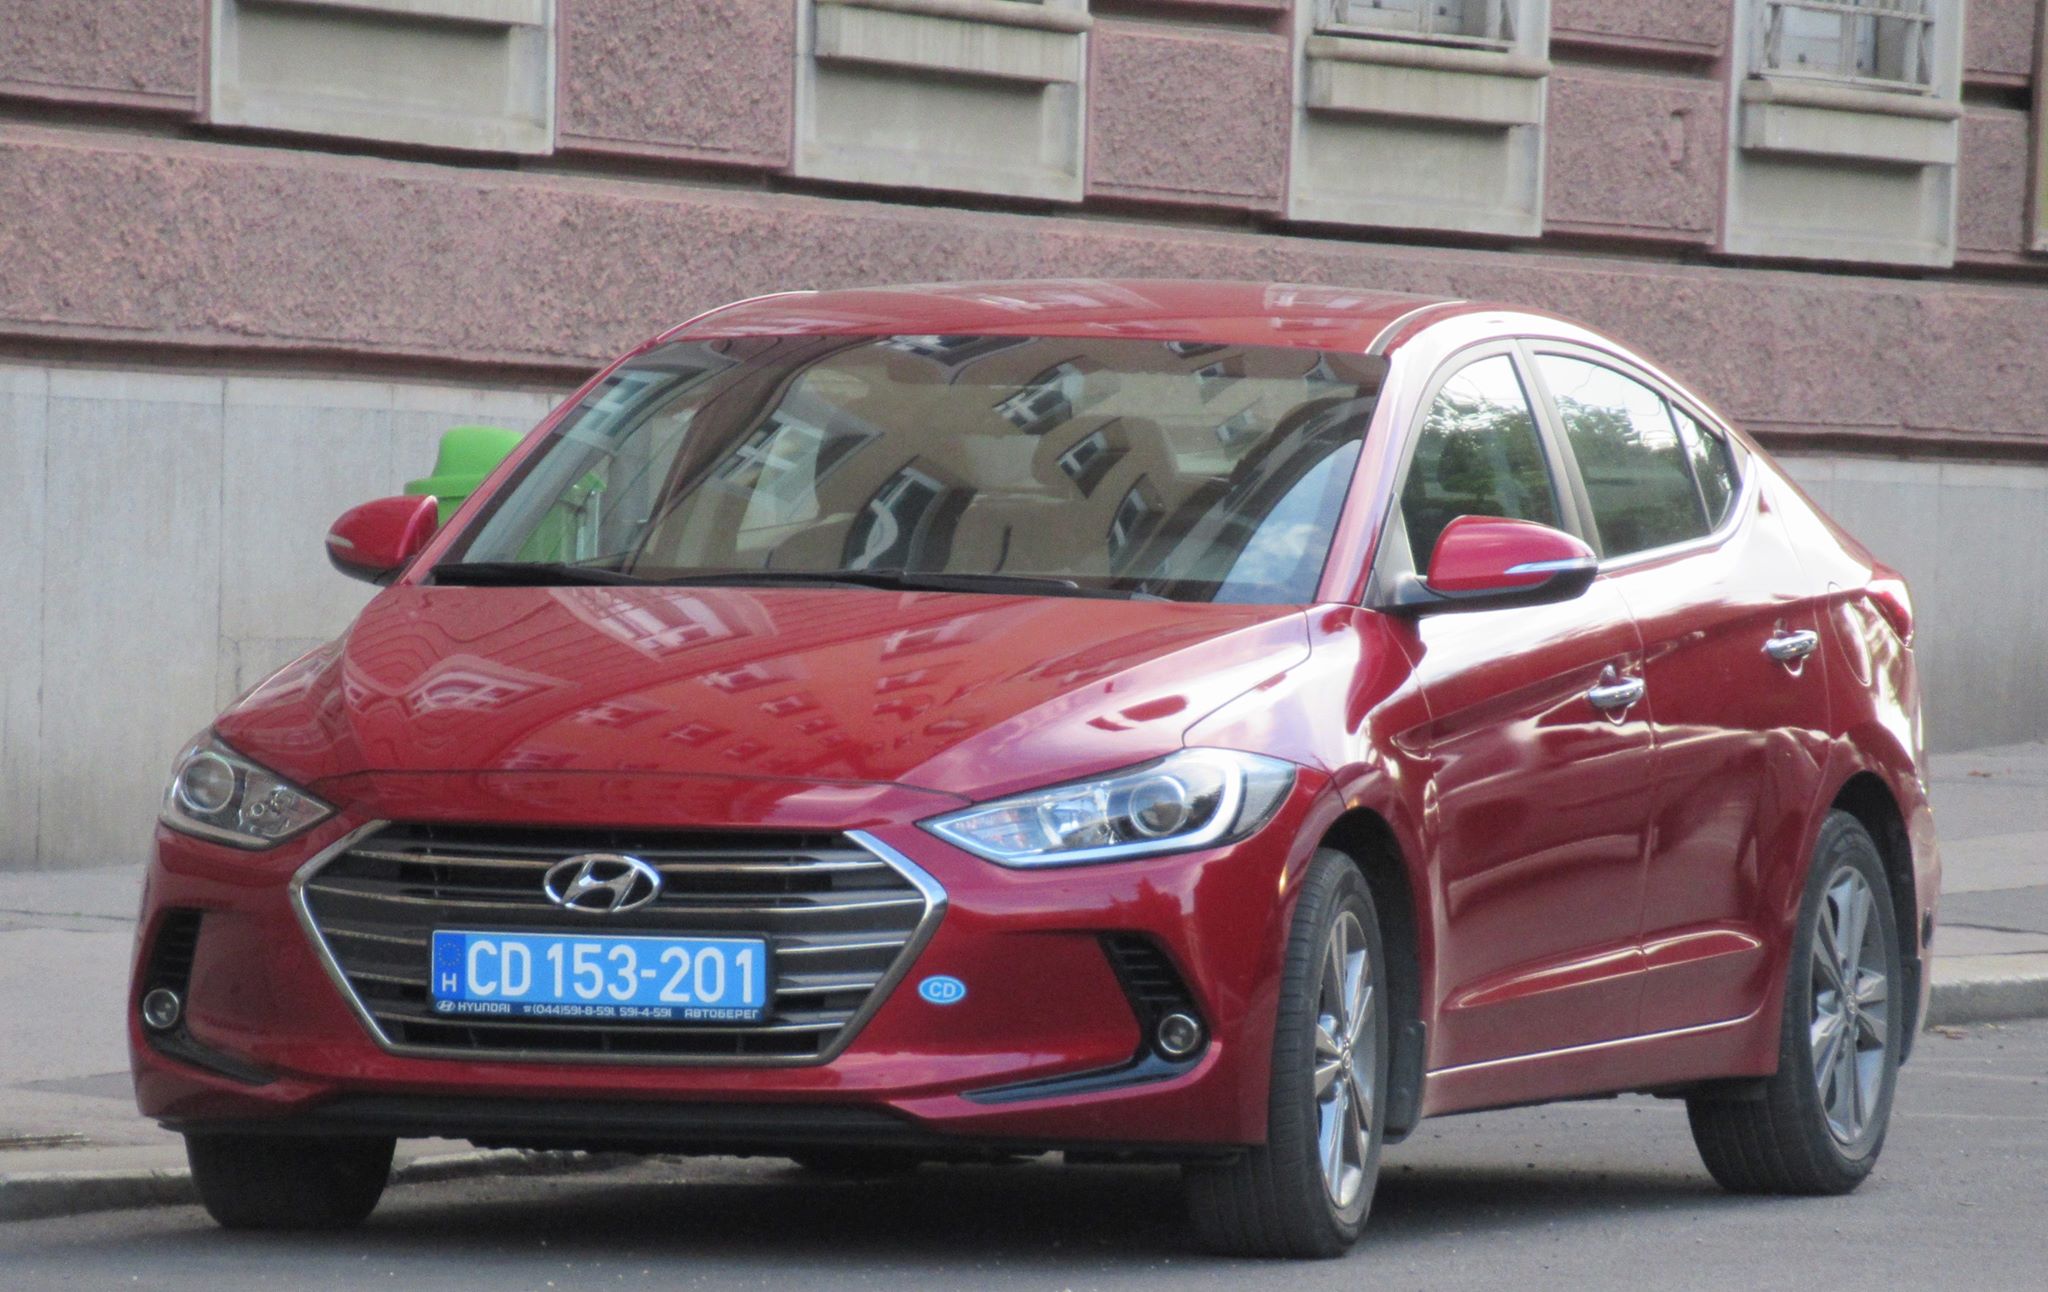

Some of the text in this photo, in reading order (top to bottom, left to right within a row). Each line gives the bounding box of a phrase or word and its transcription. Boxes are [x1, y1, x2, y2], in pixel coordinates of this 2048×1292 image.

[467, 940, 753, 1004] CD 153-201
[442, 972, 457, 992] H
[929, 982, 956, 998] CD
[458, 1001, 511, 1013] HYUNDAI
